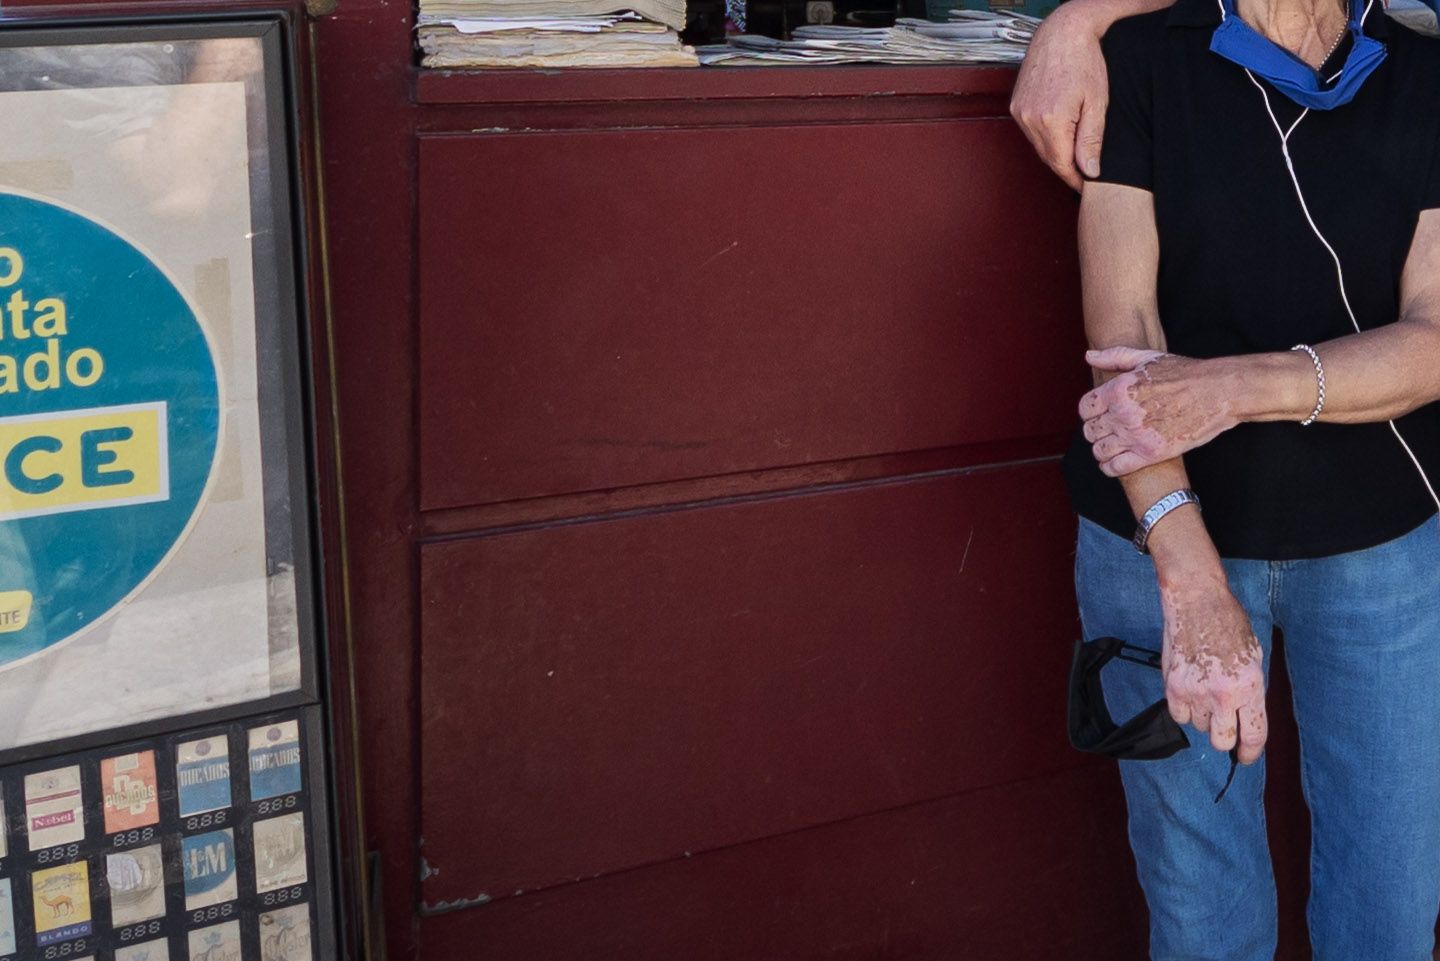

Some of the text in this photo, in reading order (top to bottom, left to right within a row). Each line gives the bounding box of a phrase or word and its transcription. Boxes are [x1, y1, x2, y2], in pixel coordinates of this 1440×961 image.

[4, 425, 136, 495] CE
[0, 609, 21, 626] TE
[40, 924, 89, 943] BLANDO
